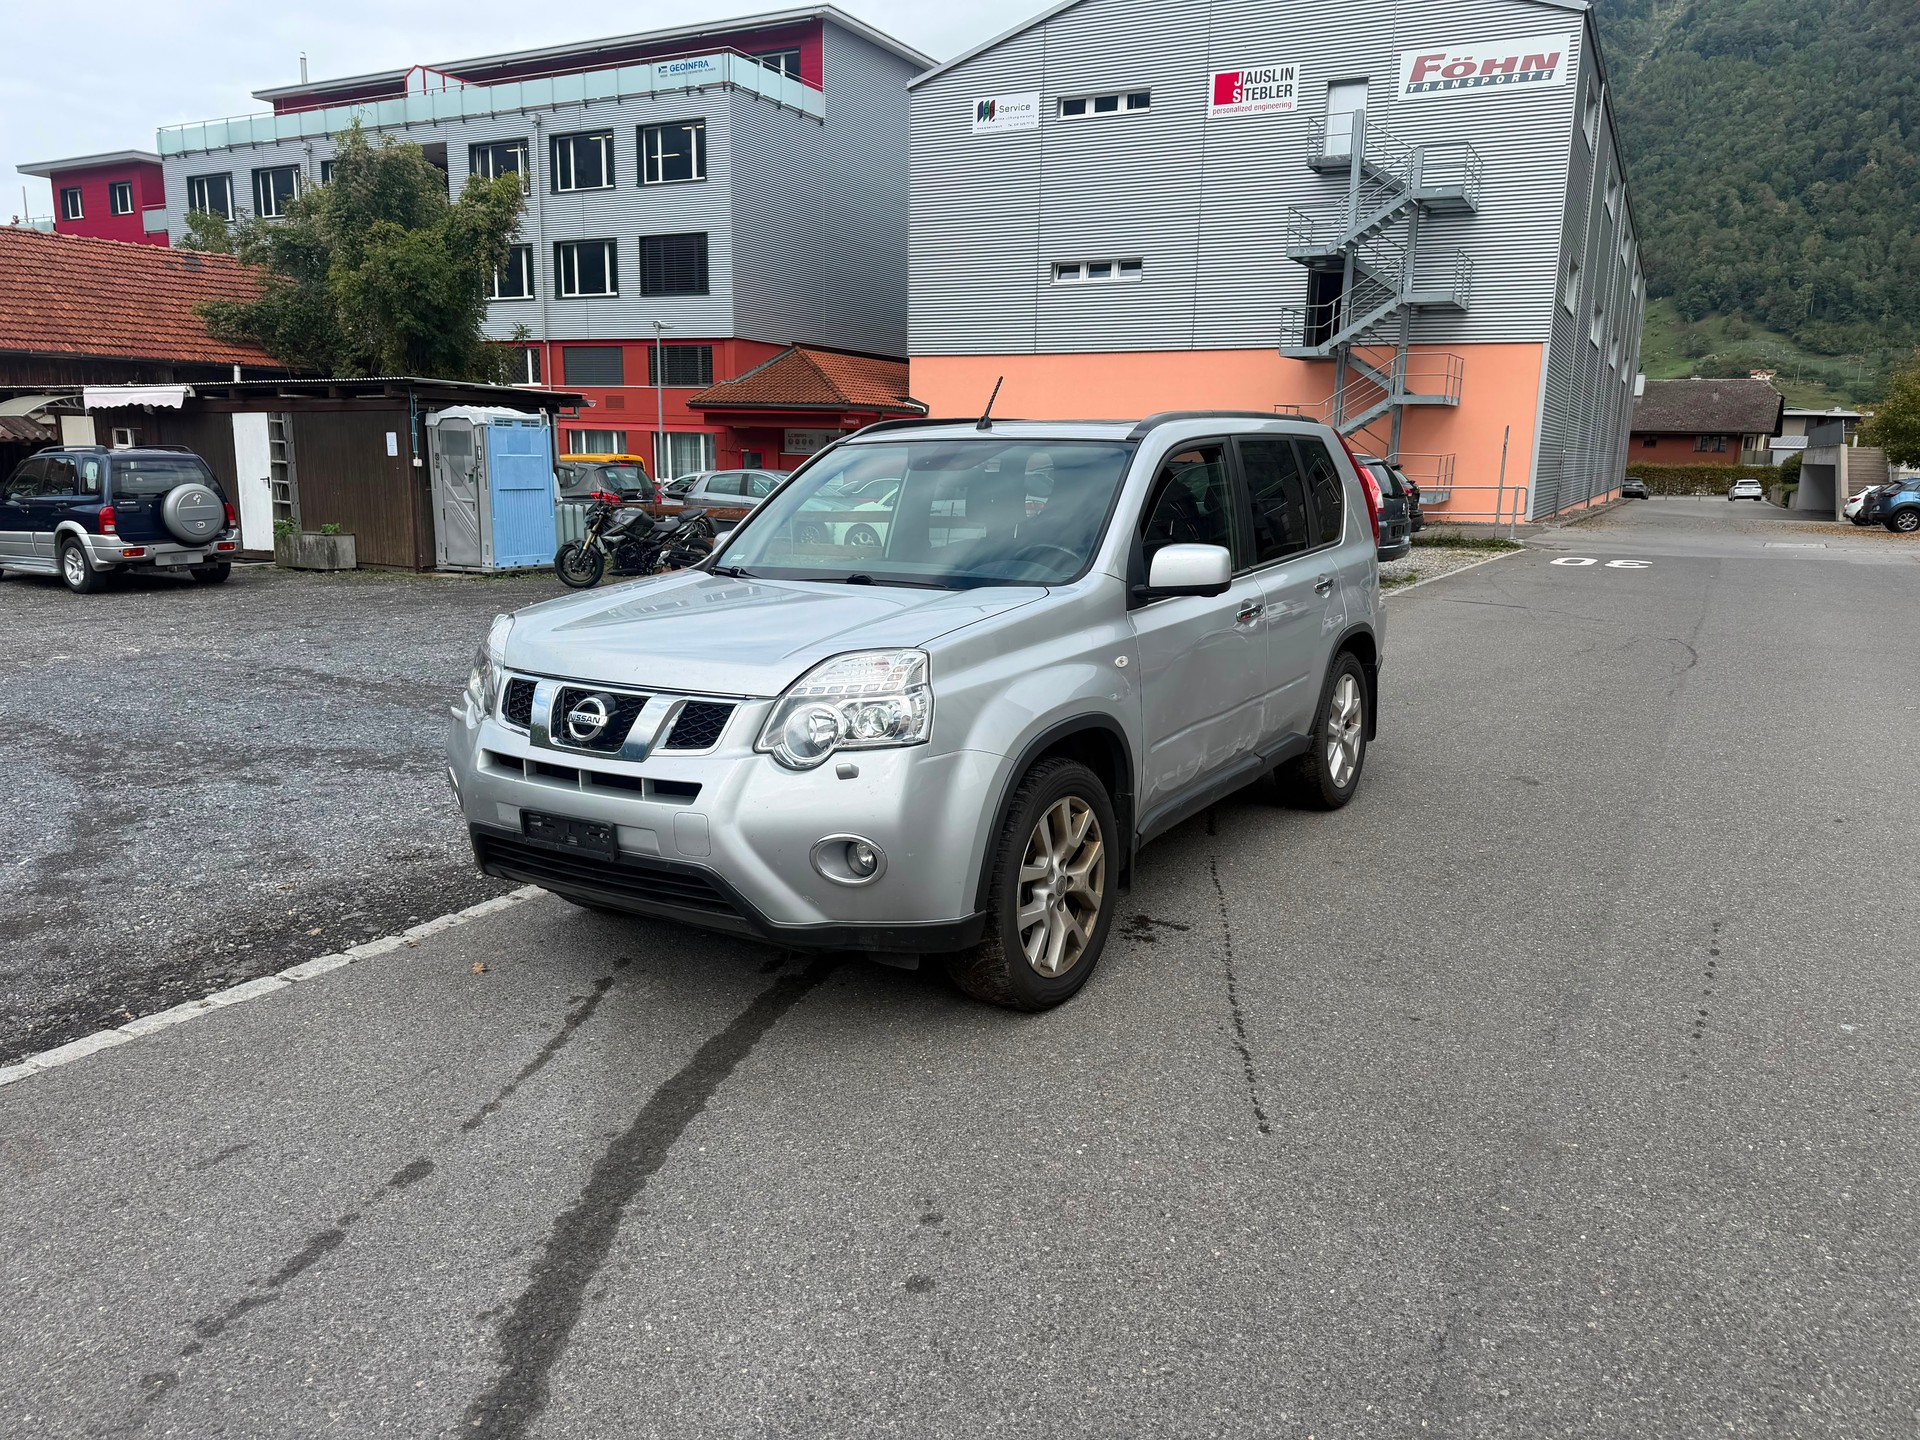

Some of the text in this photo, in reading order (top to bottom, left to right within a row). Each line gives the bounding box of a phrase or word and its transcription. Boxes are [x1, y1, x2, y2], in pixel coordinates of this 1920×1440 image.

[669, 60, 709, 72] GEOINFRA
[1409, 52, 1561, 83] FÖHN
[1234, 67, 1294, 86] JAUSLIN
[1409, 71, 1552, 93] TRANSPORTE
[1232, 84, 1293, 103] STEBLER
[1212, 102, 1292, 116] personalized engineering
[568, 713, 601, 724] NISSAN
